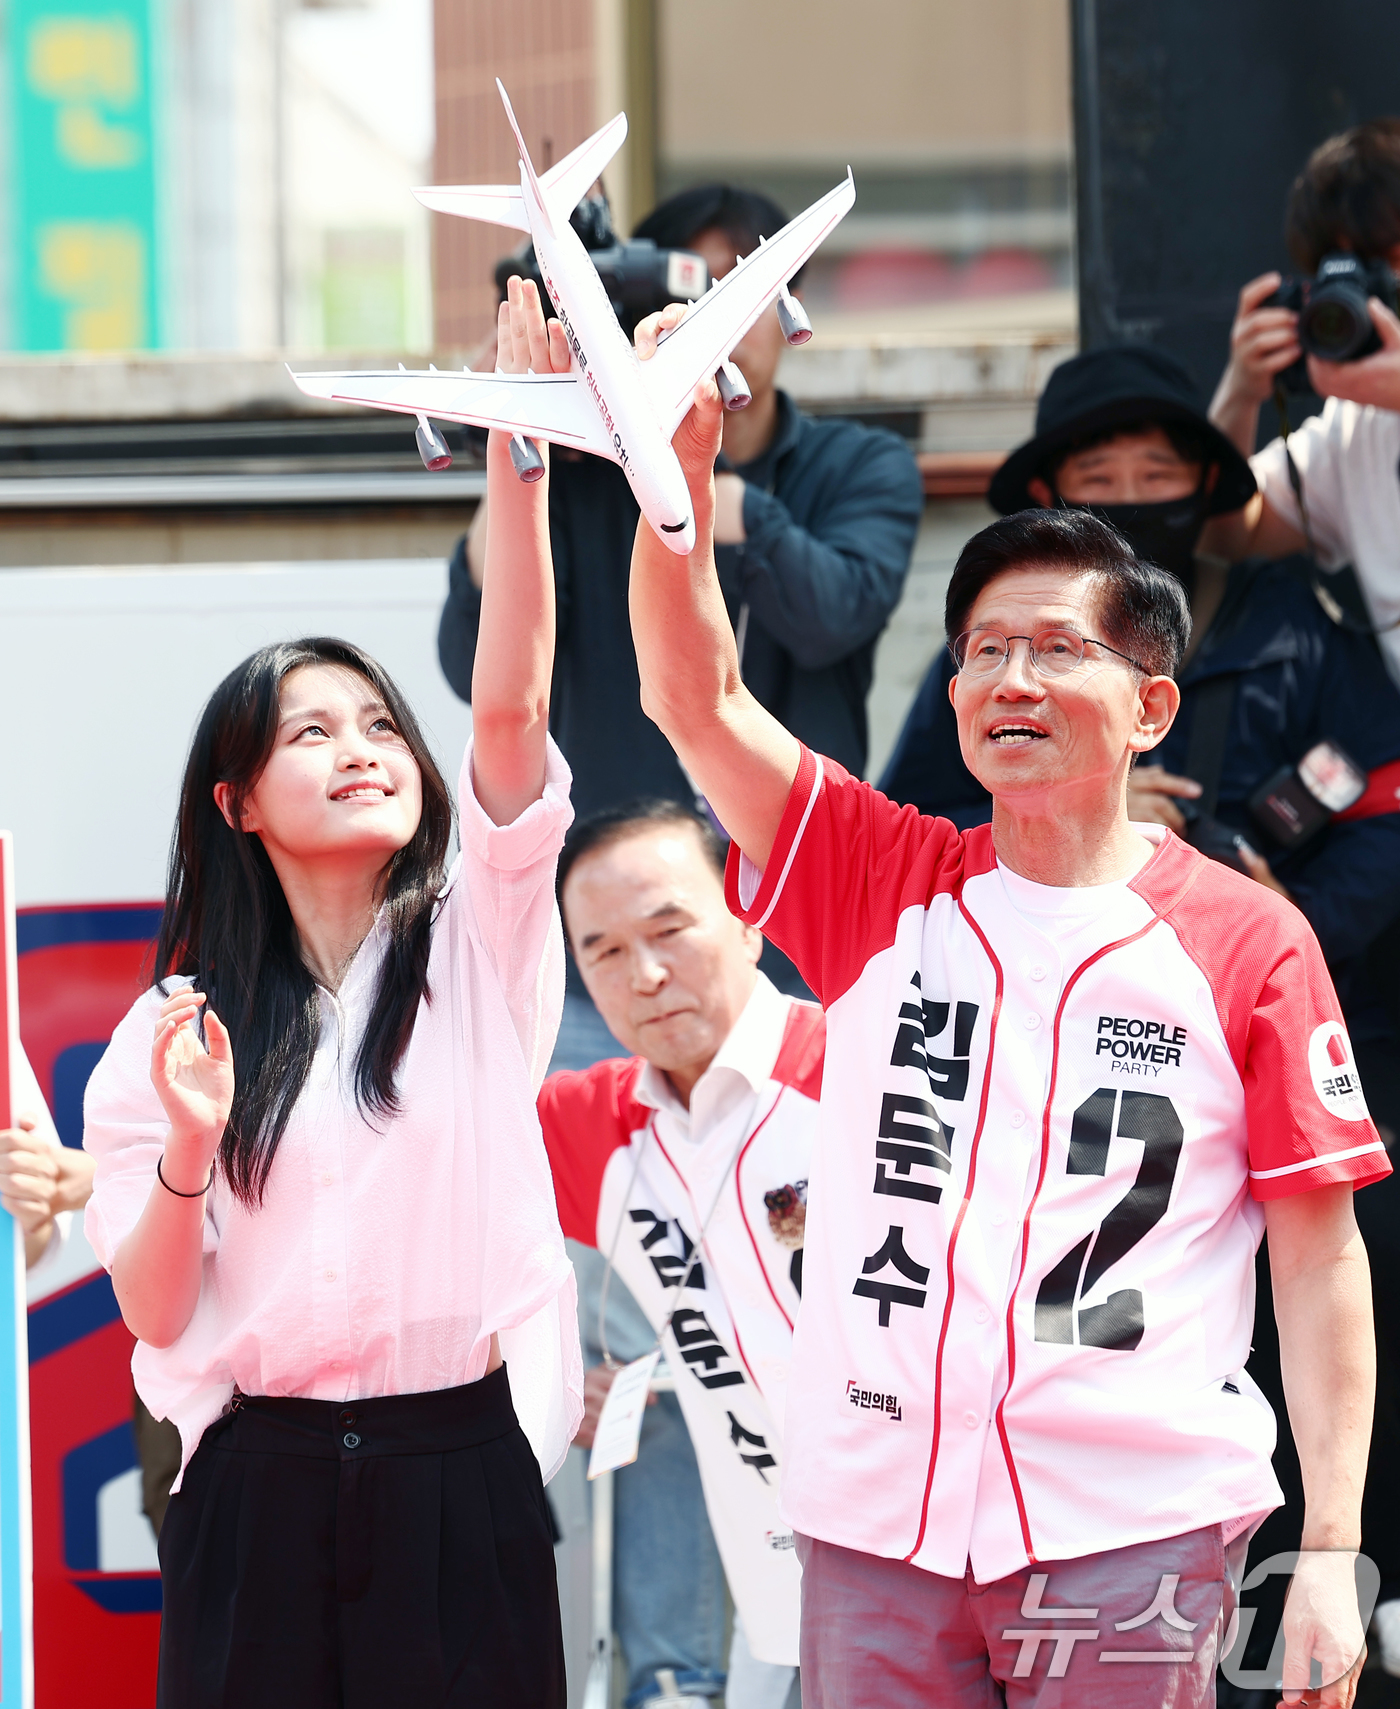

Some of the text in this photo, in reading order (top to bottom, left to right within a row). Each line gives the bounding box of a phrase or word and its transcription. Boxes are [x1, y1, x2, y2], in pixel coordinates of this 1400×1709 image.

[586, 371, 615, 436] 허브공항
[1096, 1037, 1182, 1067] POWER
[1097, 1016, 1187, 1046] PEOPLE
[1111, 1060, 1162, 1077] PARTY
[852, 970, 979, 1328] 김문수
[1034, 1087, 1185, 1352] 2
[628, 1209, 778, 1486] 김문수
[849, 1387, 898, 1415] 국민의힘
